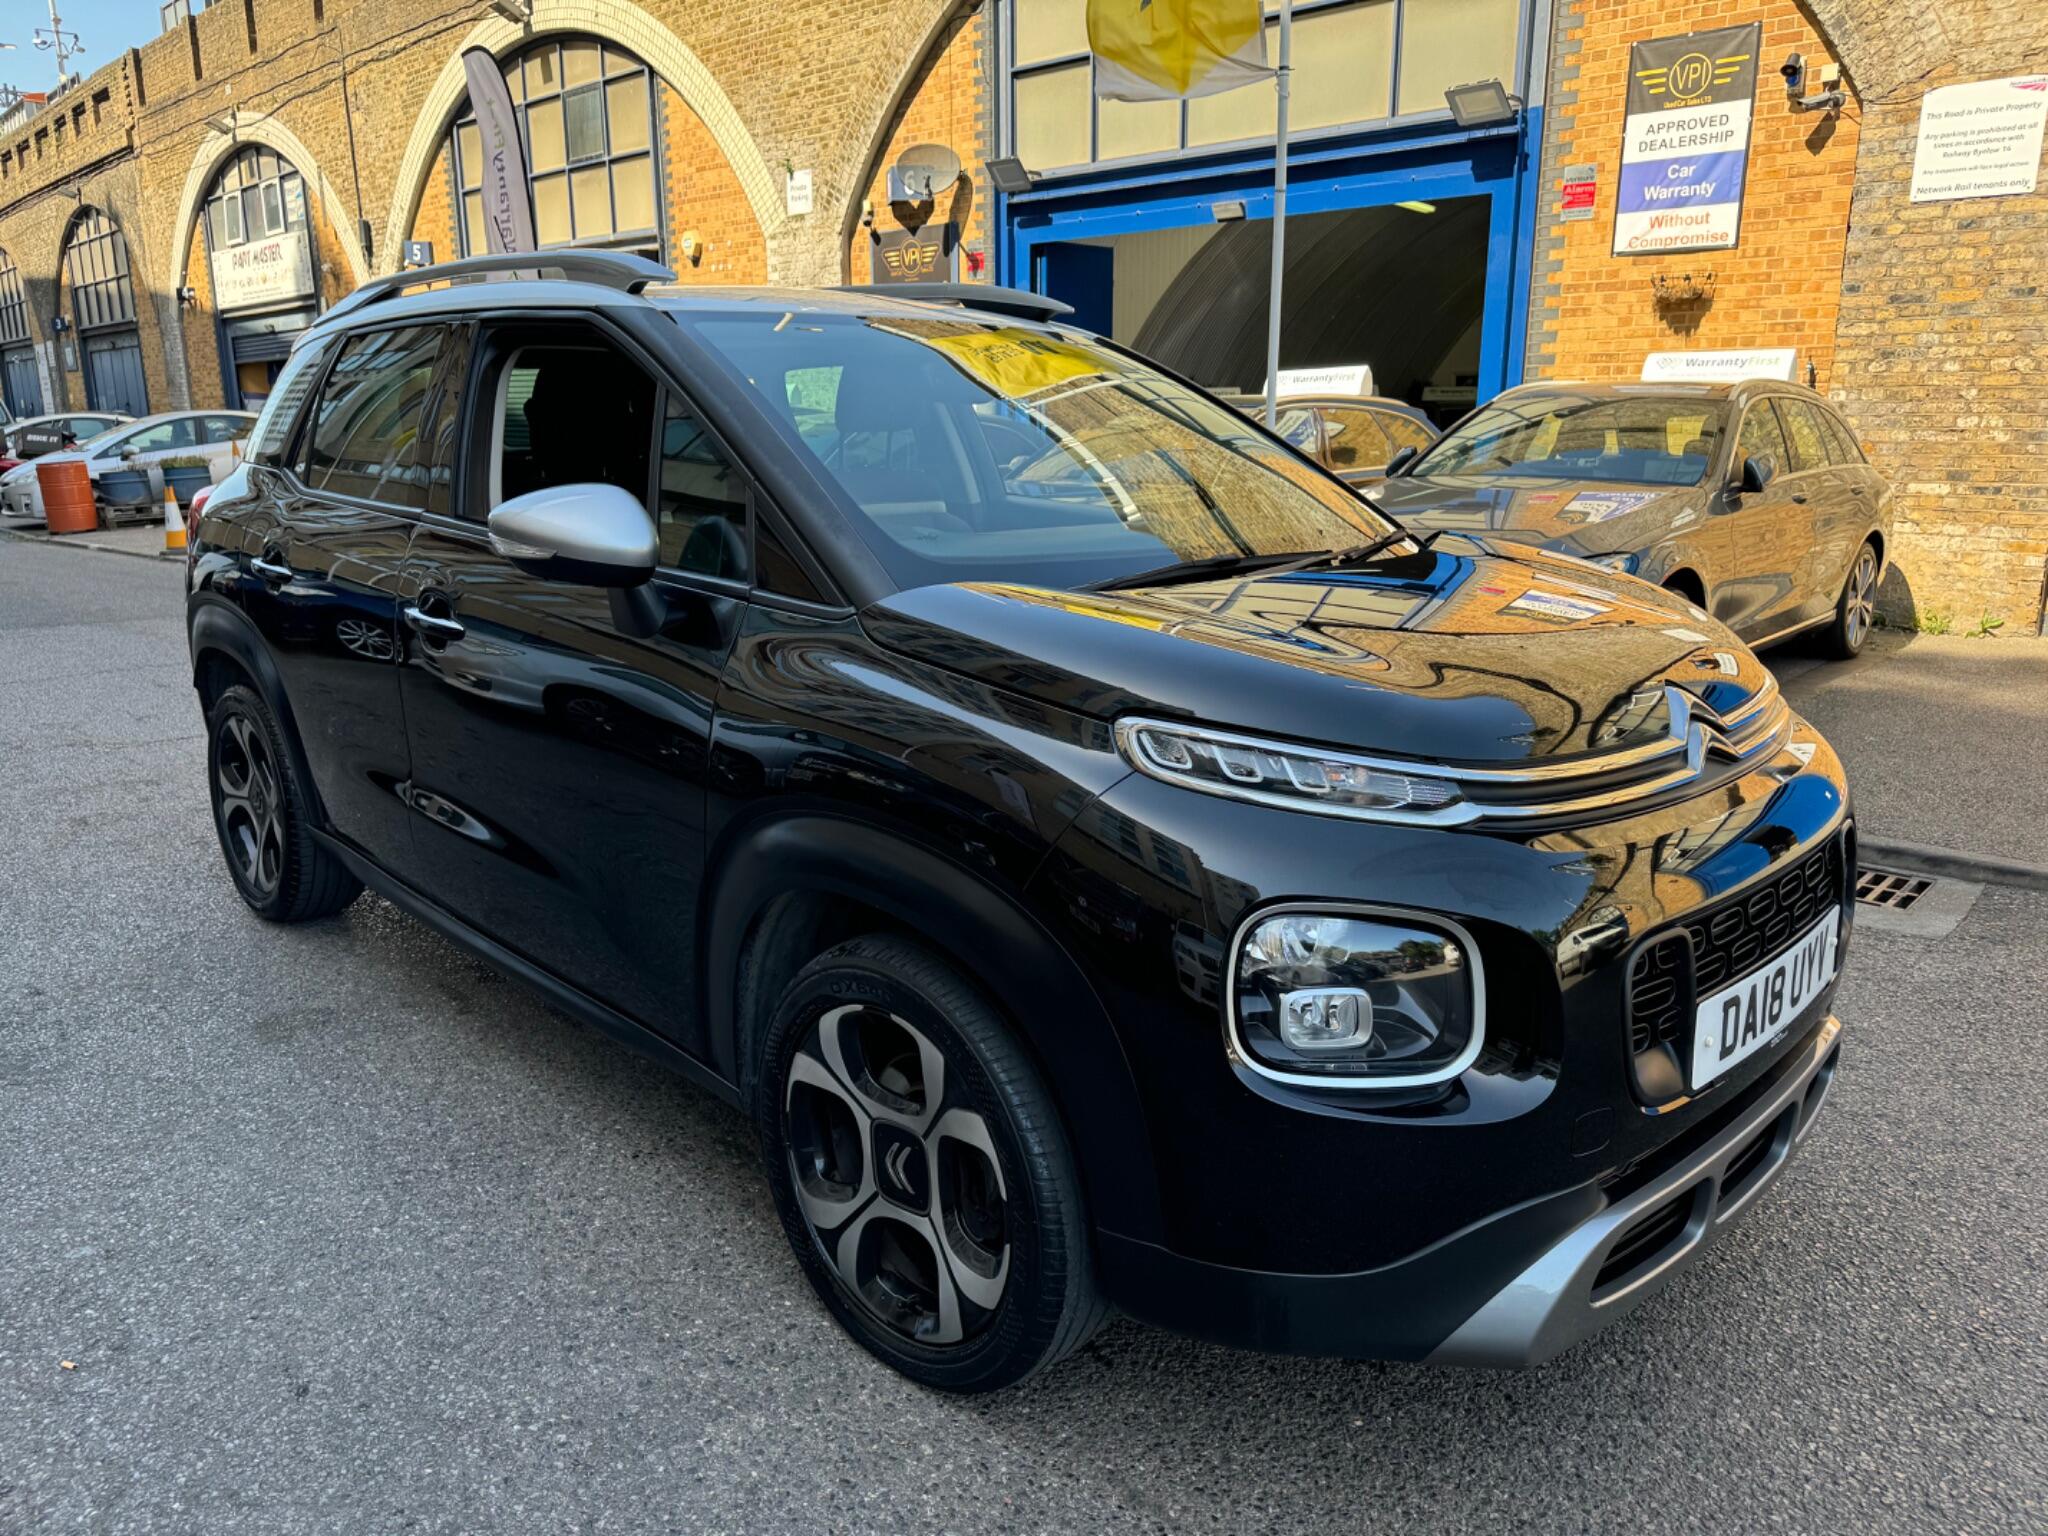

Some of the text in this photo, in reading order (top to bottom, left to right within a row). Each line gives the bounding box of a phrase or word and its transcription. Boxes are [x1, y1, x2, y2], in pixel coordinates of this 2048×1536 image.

[1675, 61, 1708, 90] VPI
[1974, 106, 2004, 115] Private
[2005, 101, 2043, 112] Property
[1645, 114, 1729, 136] APPROVED
[1638, 130, 1735, 153] DEALERSHIP
[1667, 164, 1697, 179] Car
[1564, 185, 1595, 195] Alarm
[1643, 180, 1717, 201] Warranty
[1916, 177, 2030, 194] Network Rail tenants only
[1649, 210, 1711, 230] Without
[1627, 230, 1729, 249] Compromise
[412, 244, 421, 260] 5
[55, 318, 61, 330] 3
[1685, 355, 1780, 368] WarrantyFirst
[1719, 965, 1786, 1062] DA18
